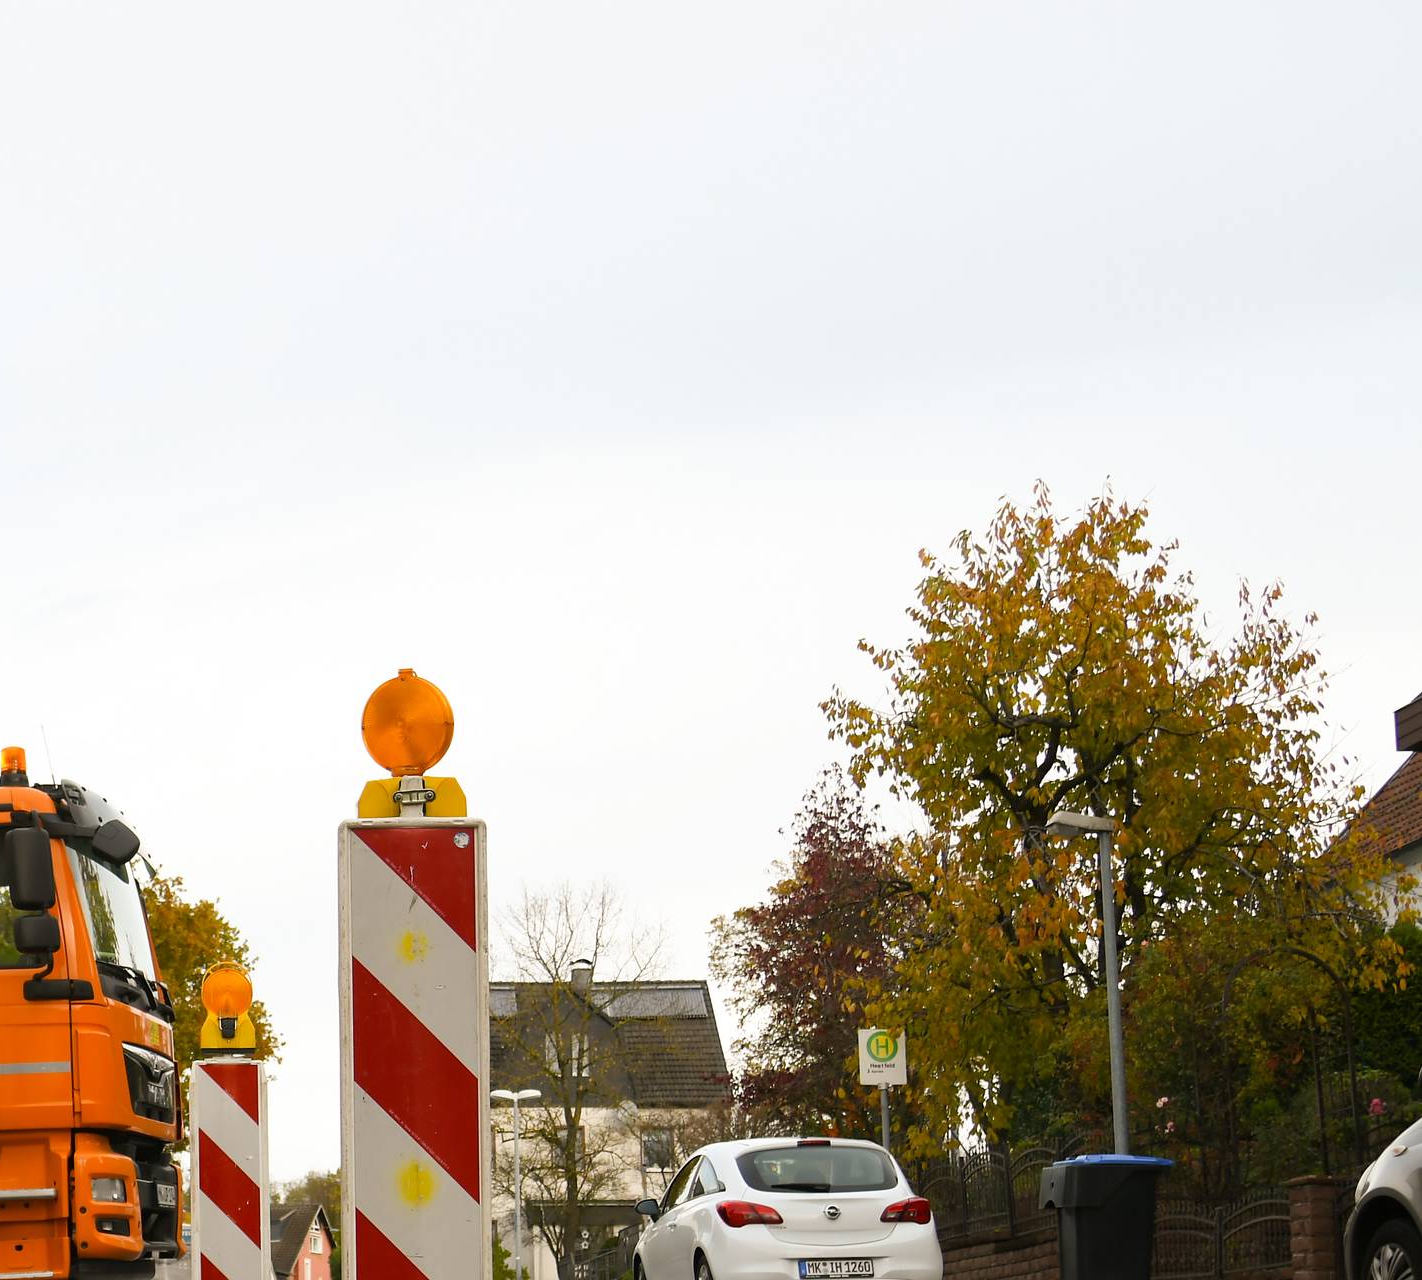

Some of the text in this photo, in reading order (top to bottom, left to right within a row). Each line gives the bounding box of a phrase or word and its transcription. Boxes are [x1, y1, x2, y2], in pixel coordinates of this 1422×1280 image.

[875, 1038, 889, 1057] H
[807, 1260, 871, 1274] MK IH 1260
